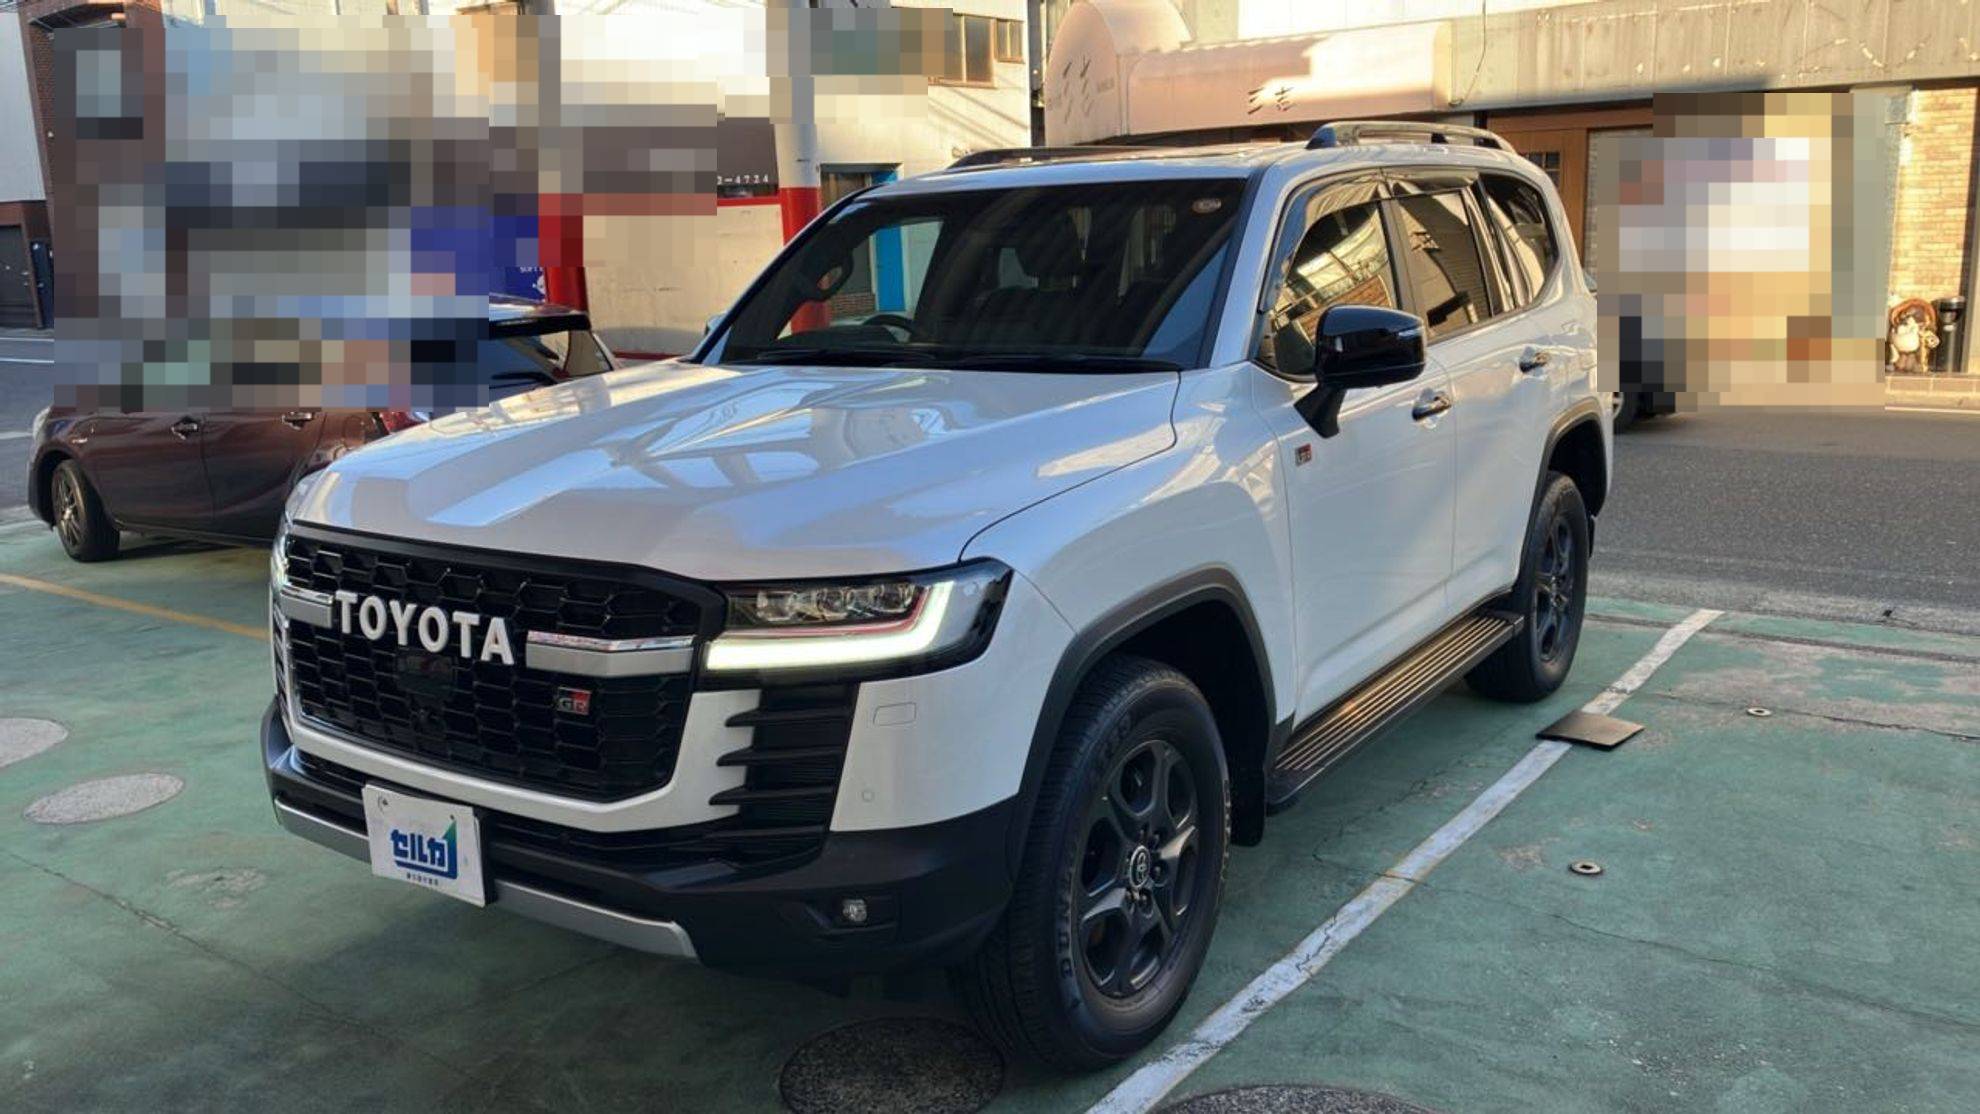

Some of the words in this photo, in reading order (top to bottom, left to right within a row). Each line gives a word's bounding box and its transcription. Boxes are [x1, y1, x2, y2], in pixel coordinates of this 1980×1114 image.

[335, 591, 514, 665] TOYOTA
[558, 694, 590, 716] GR
[390, 828, 447, 868] セルカ
